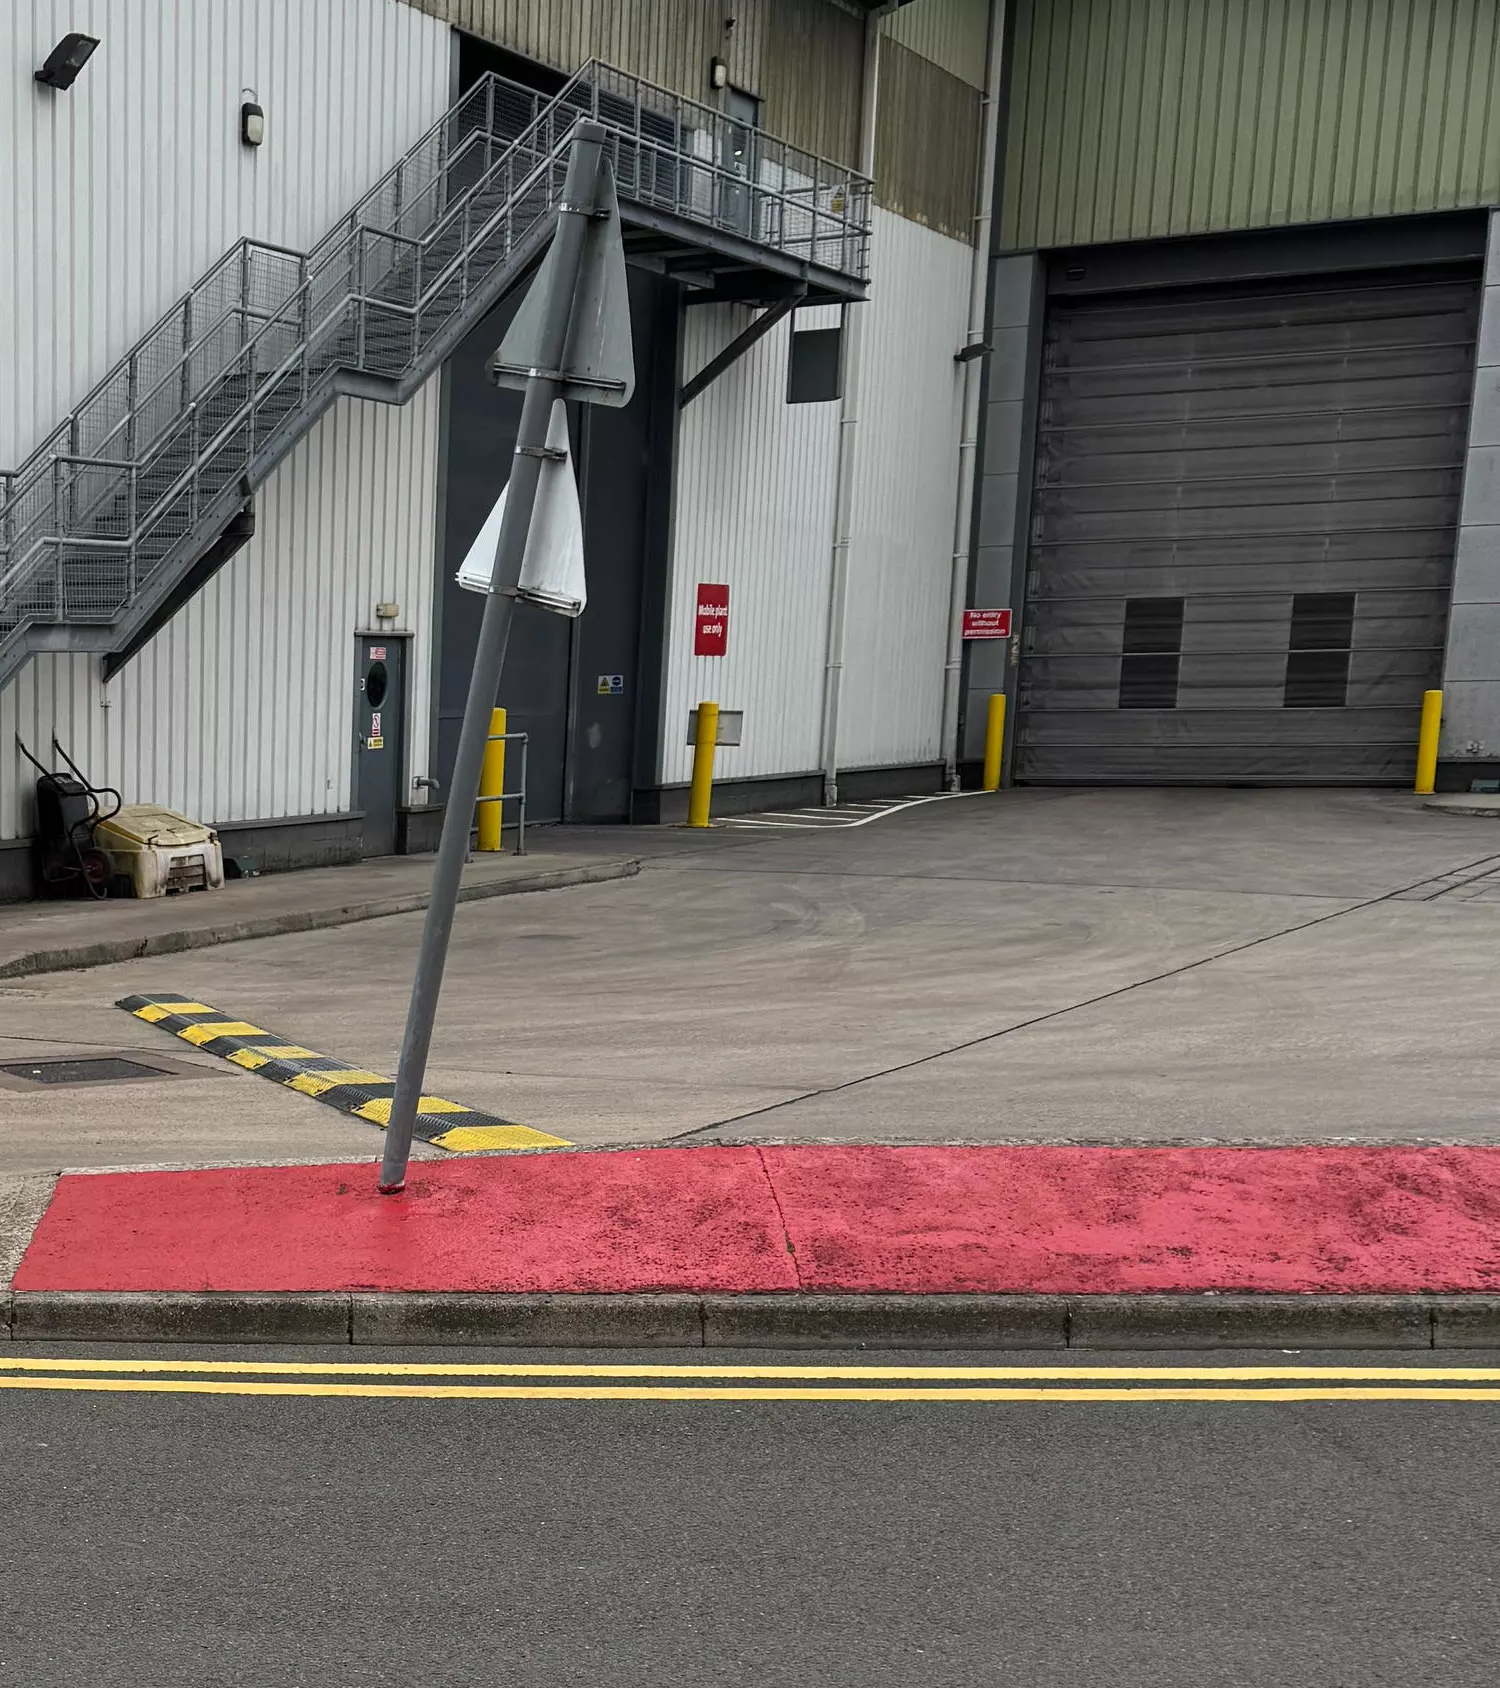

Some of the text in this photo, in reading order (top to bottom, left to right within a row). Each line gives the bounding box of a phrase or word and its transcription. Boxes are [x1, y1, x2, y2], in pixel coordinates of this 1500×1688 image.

[698, 604, 728, 619] Mobile plant
[703, 622, 722, 637] use only
